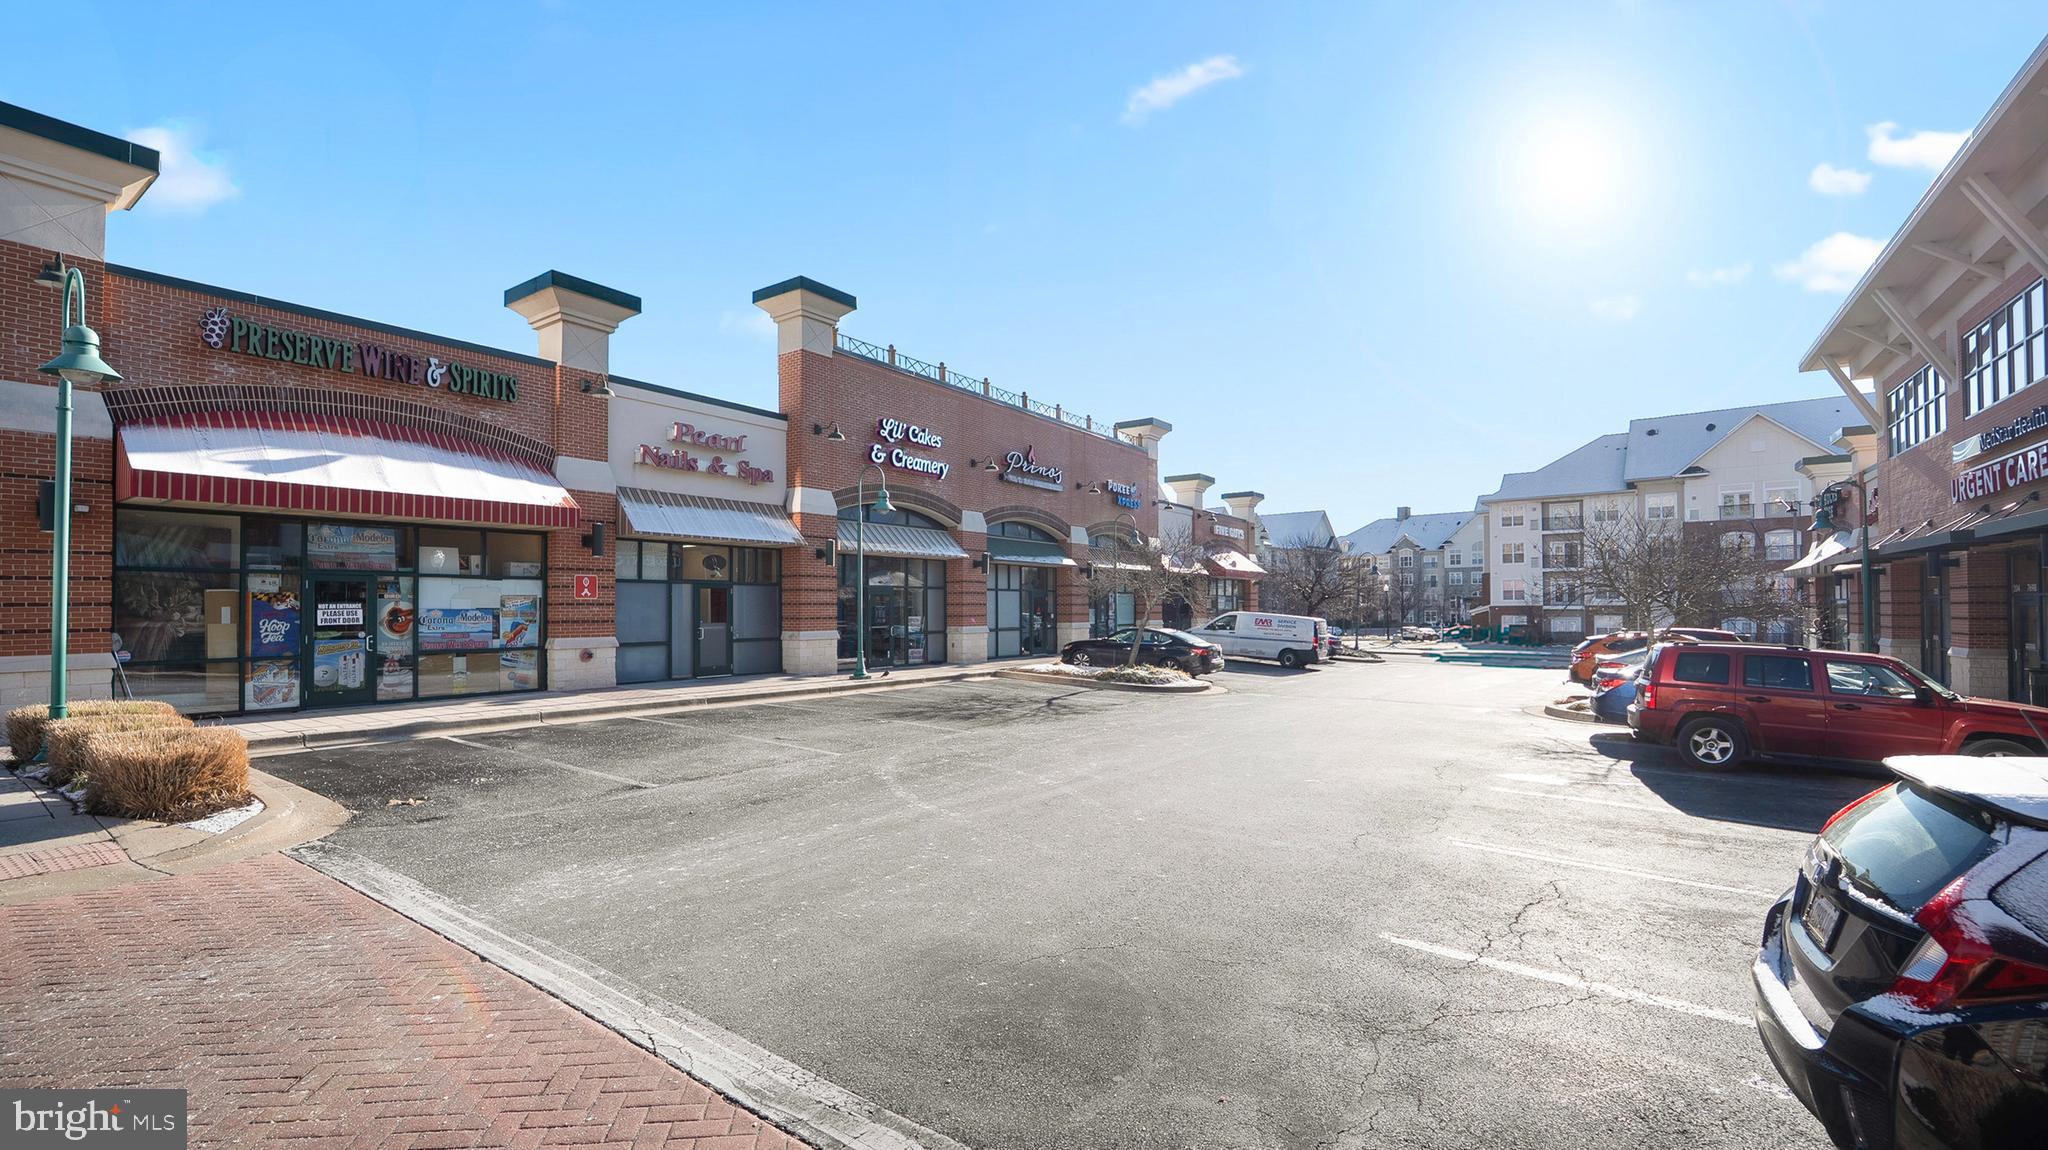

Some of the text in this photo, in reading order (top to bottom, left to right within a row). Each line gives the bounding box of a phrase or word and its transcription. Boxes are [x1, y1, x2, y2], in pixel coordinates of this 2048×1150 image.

[231, 316, 518, 402] PRESERVE WINE & SPIRITS
[669, 421, 748, 453] Pearl
[908, 424, 942, 448] Cakes
[1980, 405, 2048, 450] MedStar Health
[637, 443, 774, 485] Nails & Spa
[870, 444, 949, 480] & Creamery
[1950, 445, 2048, 504] URGENT CARE
[1117, 496, 1141, 510] XPRESS
[1214, 525, 1244, 539] FIVE GUYS
[259, 619, 290, 635] Hoop
[419, 612, 488, 626] Corona Modelo
[260, 632, 285, 643] Tea
